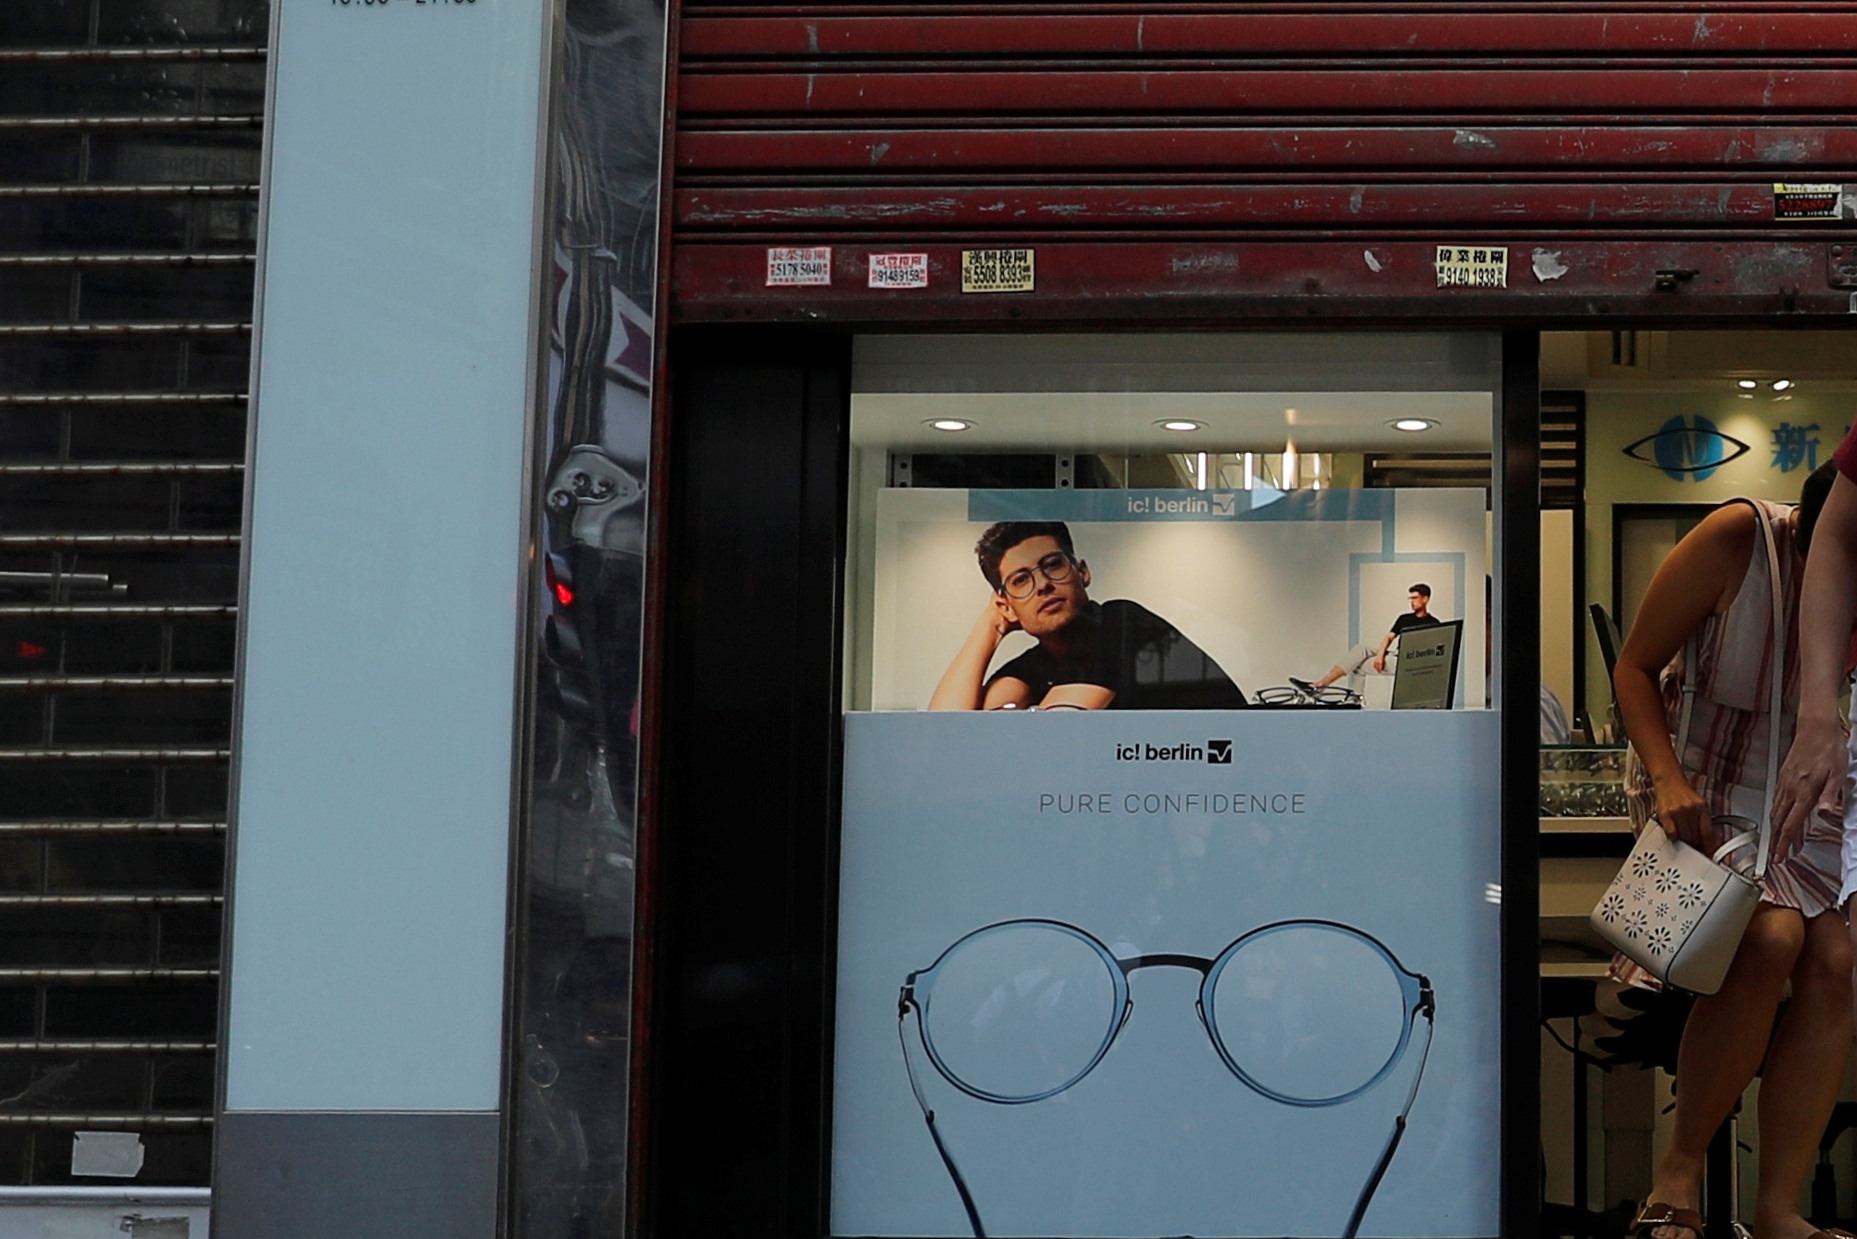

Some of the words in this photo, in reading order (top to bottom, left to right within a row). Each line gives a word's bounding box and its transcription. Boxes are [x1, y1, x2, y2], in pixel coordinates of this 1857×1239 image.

[1446, 267, 1469, 286] 9140
[1474, 267, 1496, 286] 1938
[1770, 421, 1846, 473] 新
[1127, 497, 1150, 512] ic!
[1154, 497, 1209, 513] berlin
[1115, 742, 1140, 761] ic!
[1144, 742, 1204, 761] berlin
[1039, 793, 1112, 814] PURE
[1123, 793, 1306, 814] CONFIDENCE
